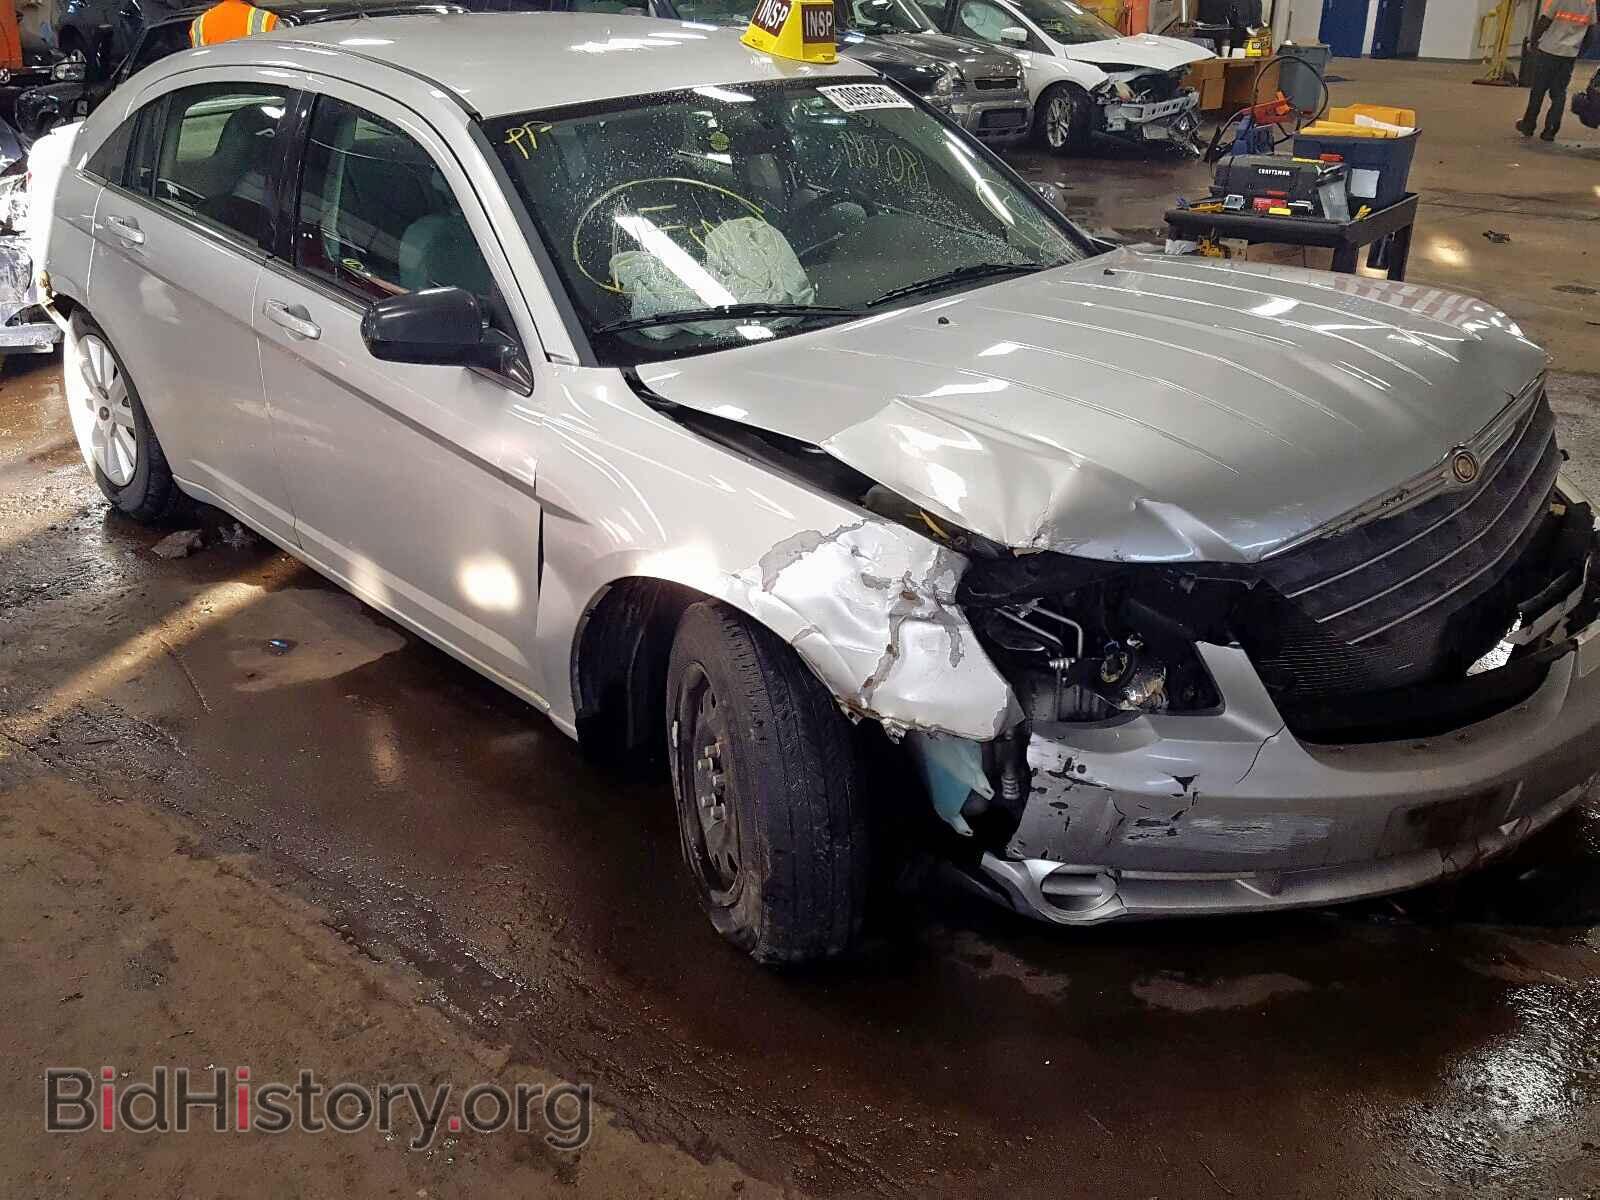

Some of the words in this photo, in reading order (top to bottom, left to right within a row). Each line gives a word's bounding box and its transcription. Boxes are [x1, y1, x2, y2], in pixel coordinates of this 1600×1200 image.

[757, 0, 789, 29] INSP
[805, 10, 833, 37] INSP
[1258, 168, 1291, 177] CRAFTSMAN
